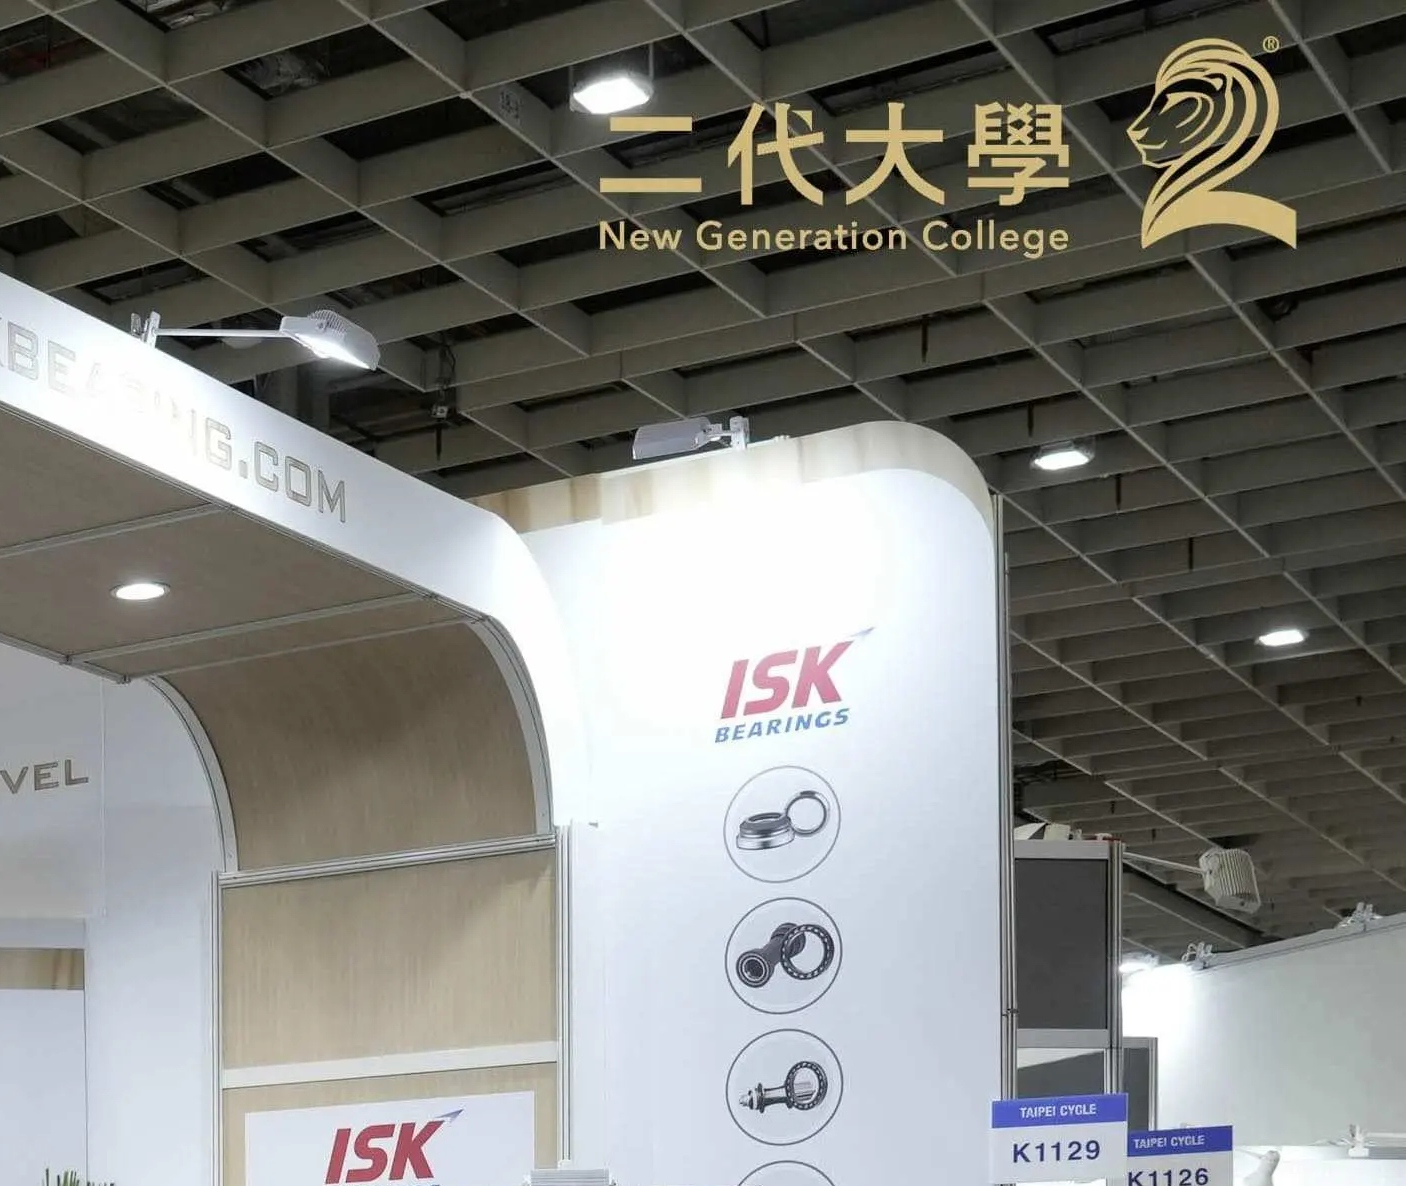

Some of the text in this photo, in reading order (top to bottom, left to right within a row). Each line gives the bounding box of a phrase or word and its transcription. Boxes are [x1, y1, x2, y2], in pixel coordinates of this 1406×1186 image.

[720, 640, 855, 719] ISK
[714, 708, 849, 743] BEARINGS
[1020, 1104, 1097, 1119] TAIPEI CYCLE
[325, 1120, 444, 1184] ISK
[1013, 1140, 1100, 1163] K1129
[1134, 1135, 1205, 1149] TAIPEI CYCLE
